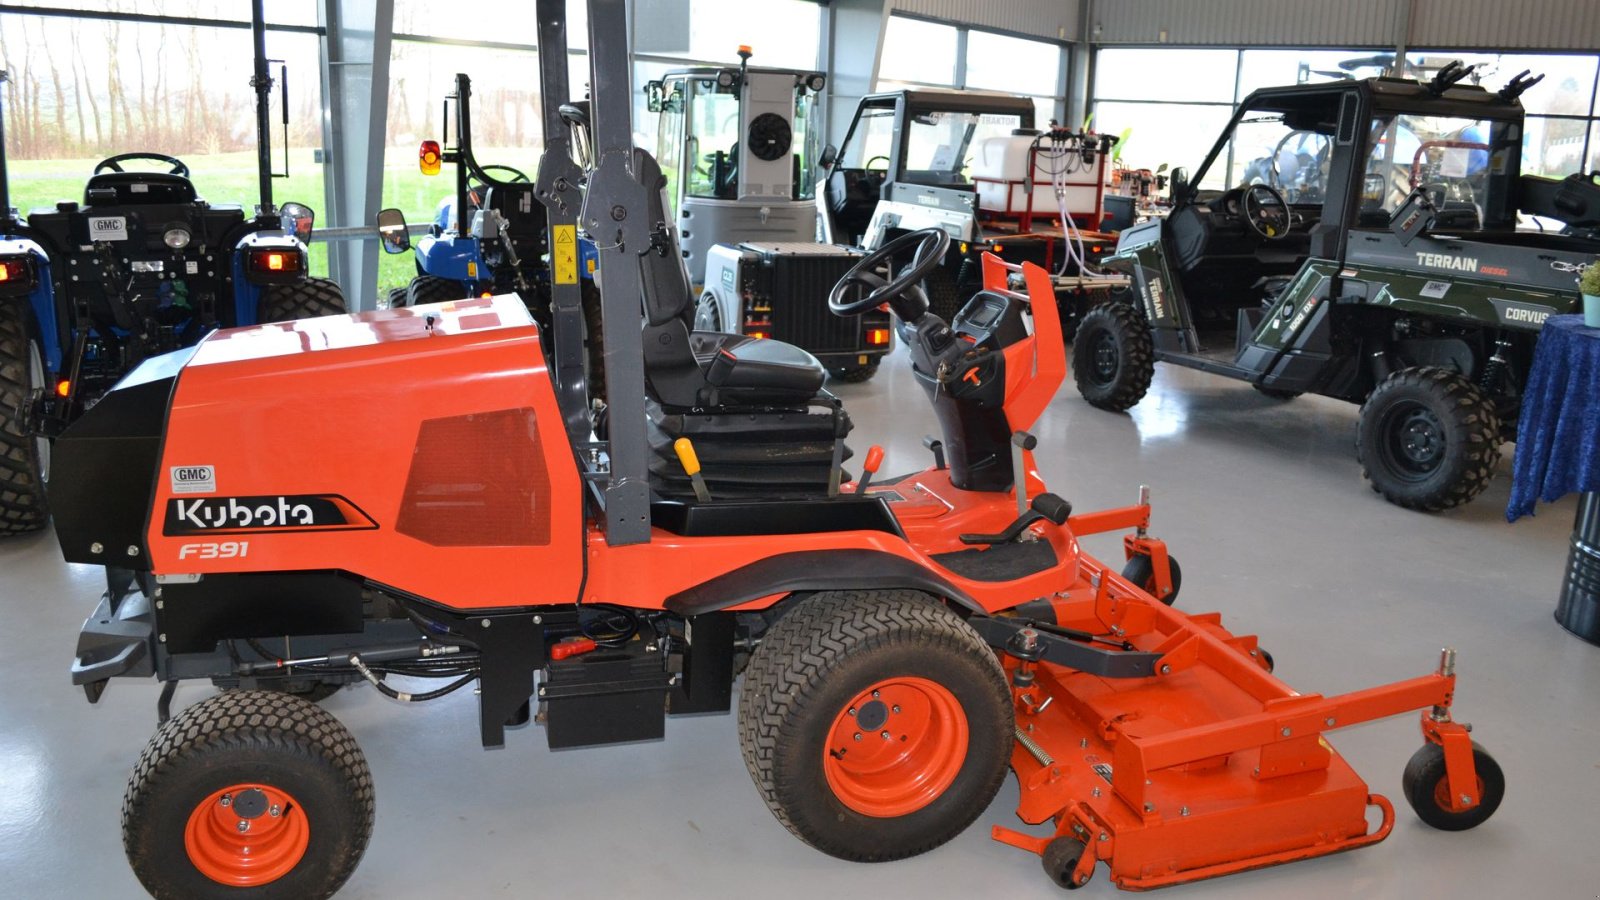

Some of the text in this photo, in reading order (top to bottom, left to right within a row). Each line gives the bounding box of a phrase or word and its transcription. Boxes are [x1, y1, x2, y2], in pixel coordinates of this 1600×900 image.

[981, 115, 1016, 126] TRAKTOR
[97, 220, 119, 231] GMC
[1416, 252, 1478, 272] TERRAIN
[1149, 278, 1165, 318] TERRAIN
[1505, 307, 1550, 324] CORVUS
[179, 468, 206, 480] GMC
[177, 497, 314, 528] Kubota
[179, 541, 249, 560] F391
